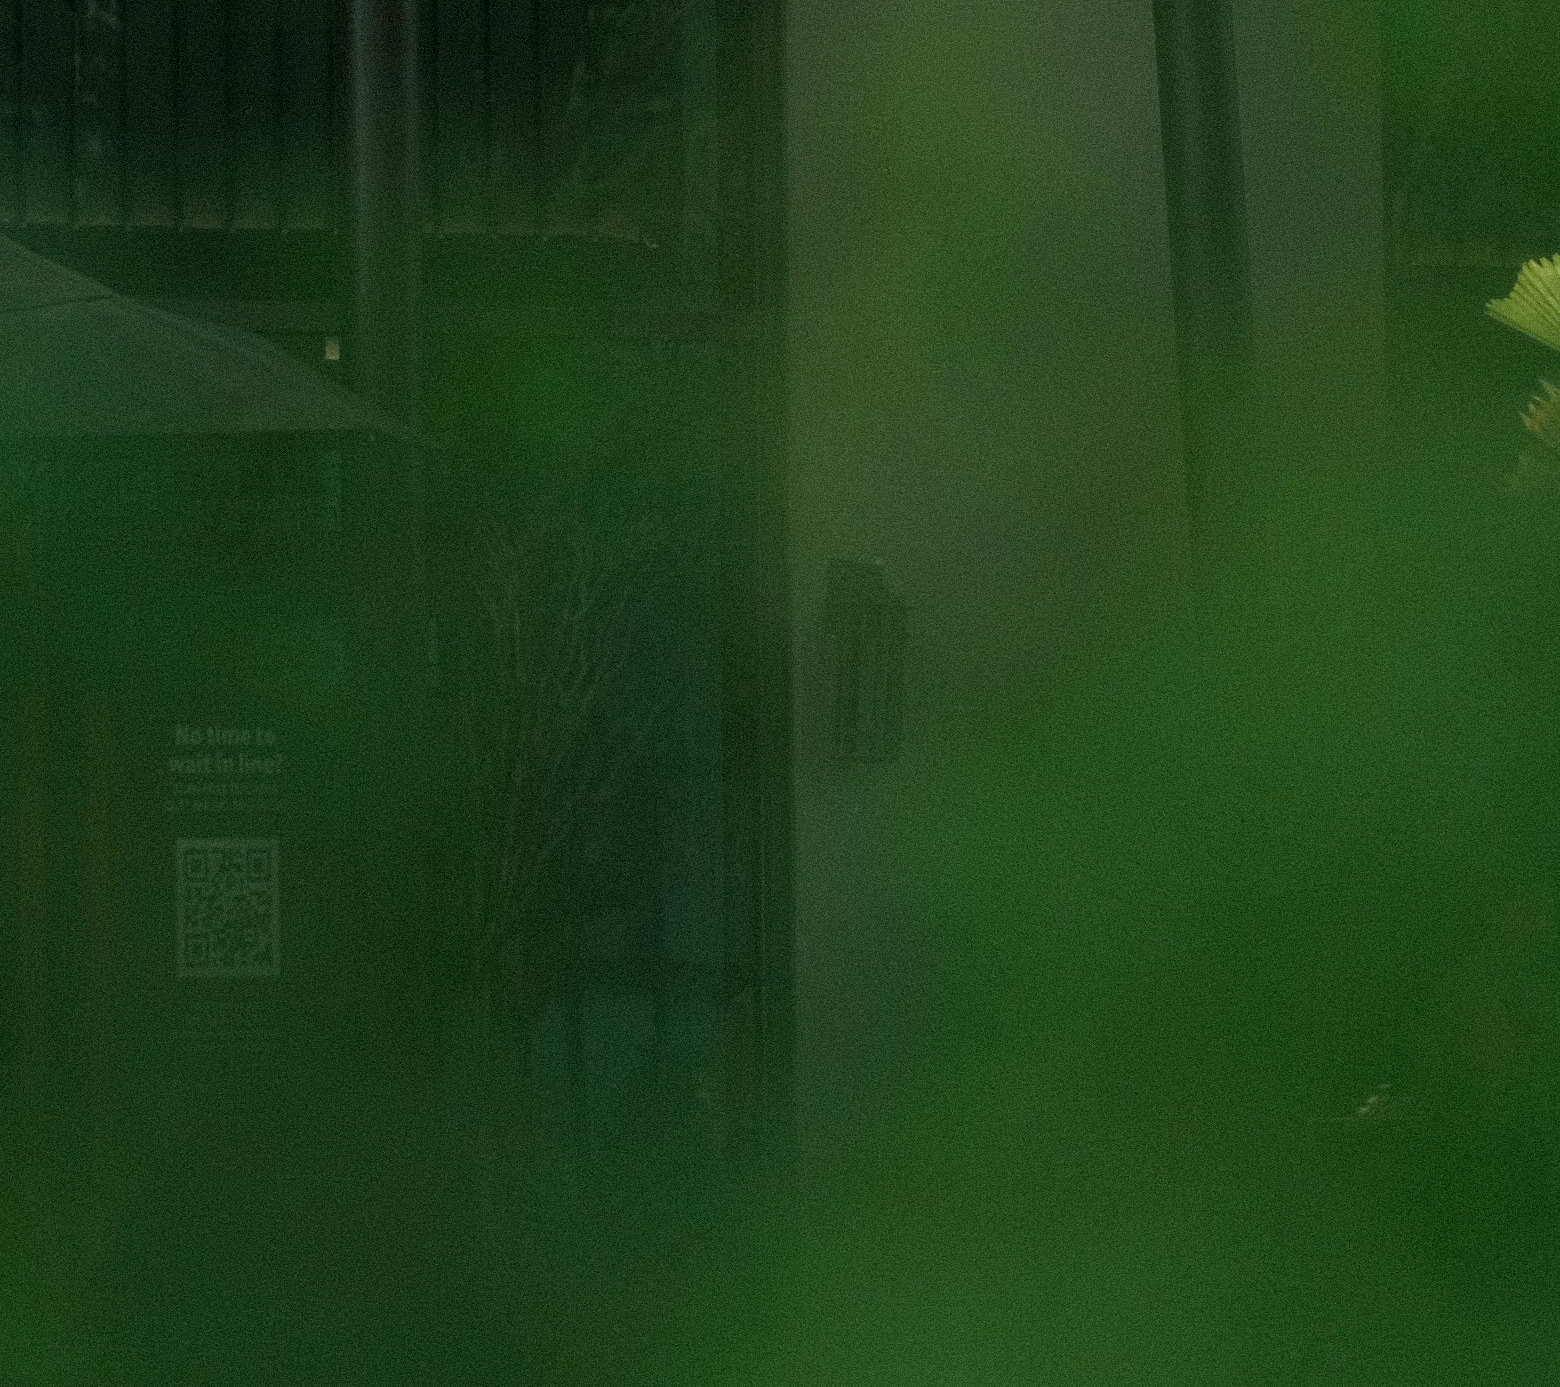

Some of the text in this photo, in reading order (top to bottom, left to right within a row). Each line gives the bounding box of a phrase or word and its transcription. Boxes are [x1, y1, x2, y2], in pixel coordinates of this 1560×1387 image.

[174, 722, 204, 746] No
[206, 722, 252, 746] time
[167, 753, 211, 774] wait
